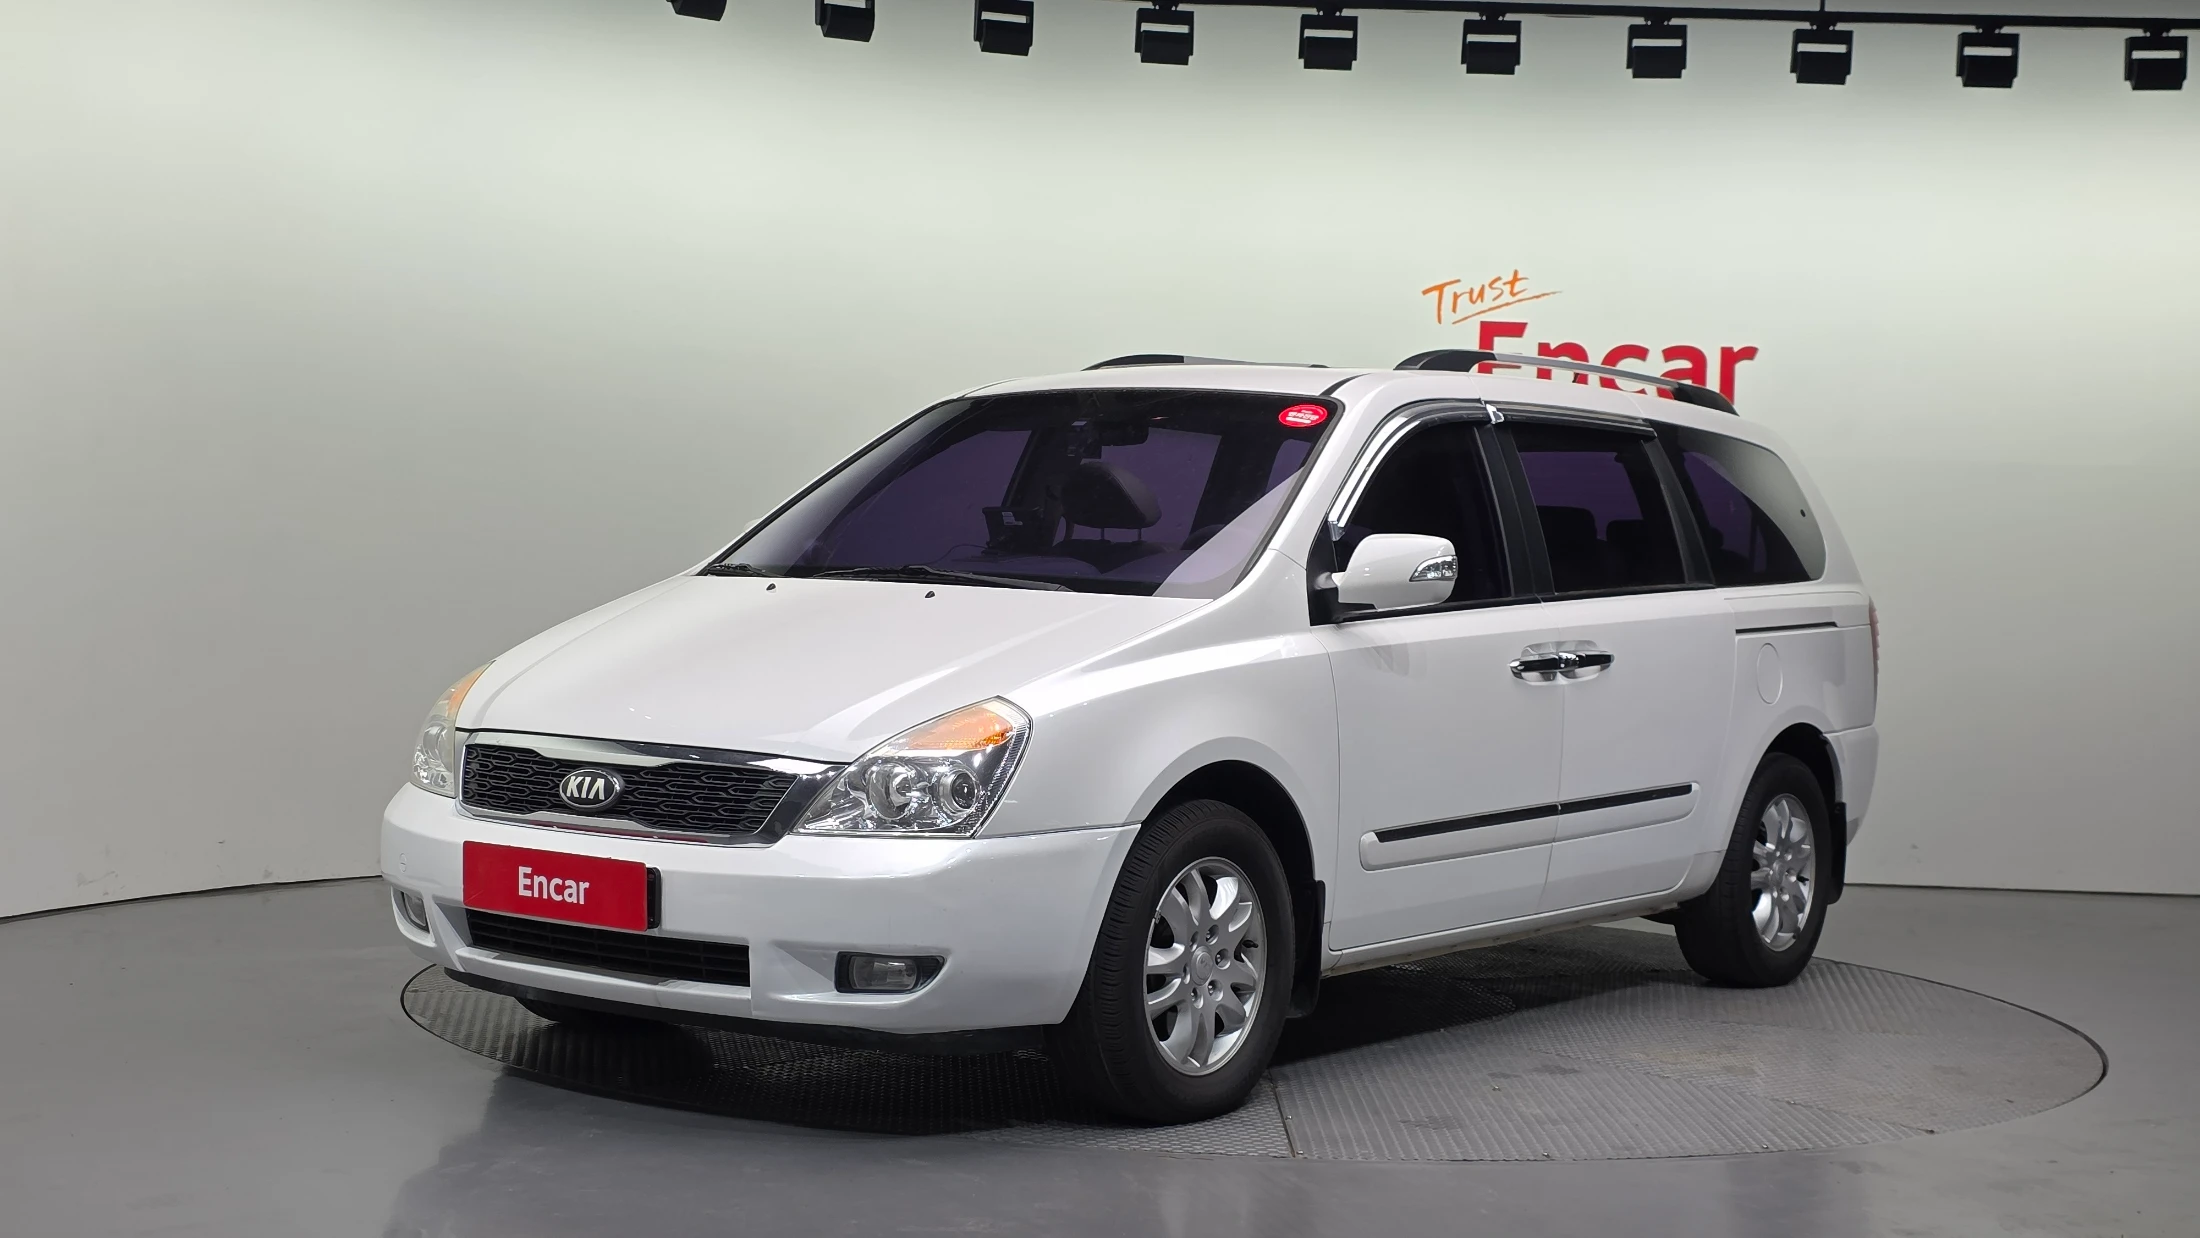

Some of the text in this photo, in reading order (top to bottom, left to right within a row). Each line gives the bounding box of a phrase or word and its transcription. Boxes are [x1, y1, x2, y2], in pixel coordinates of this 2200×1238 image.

[1421, 269, 1530, 325] Trust
[566, 775, 605, 801] KIA
[517, 865, 590, 905] Encar
